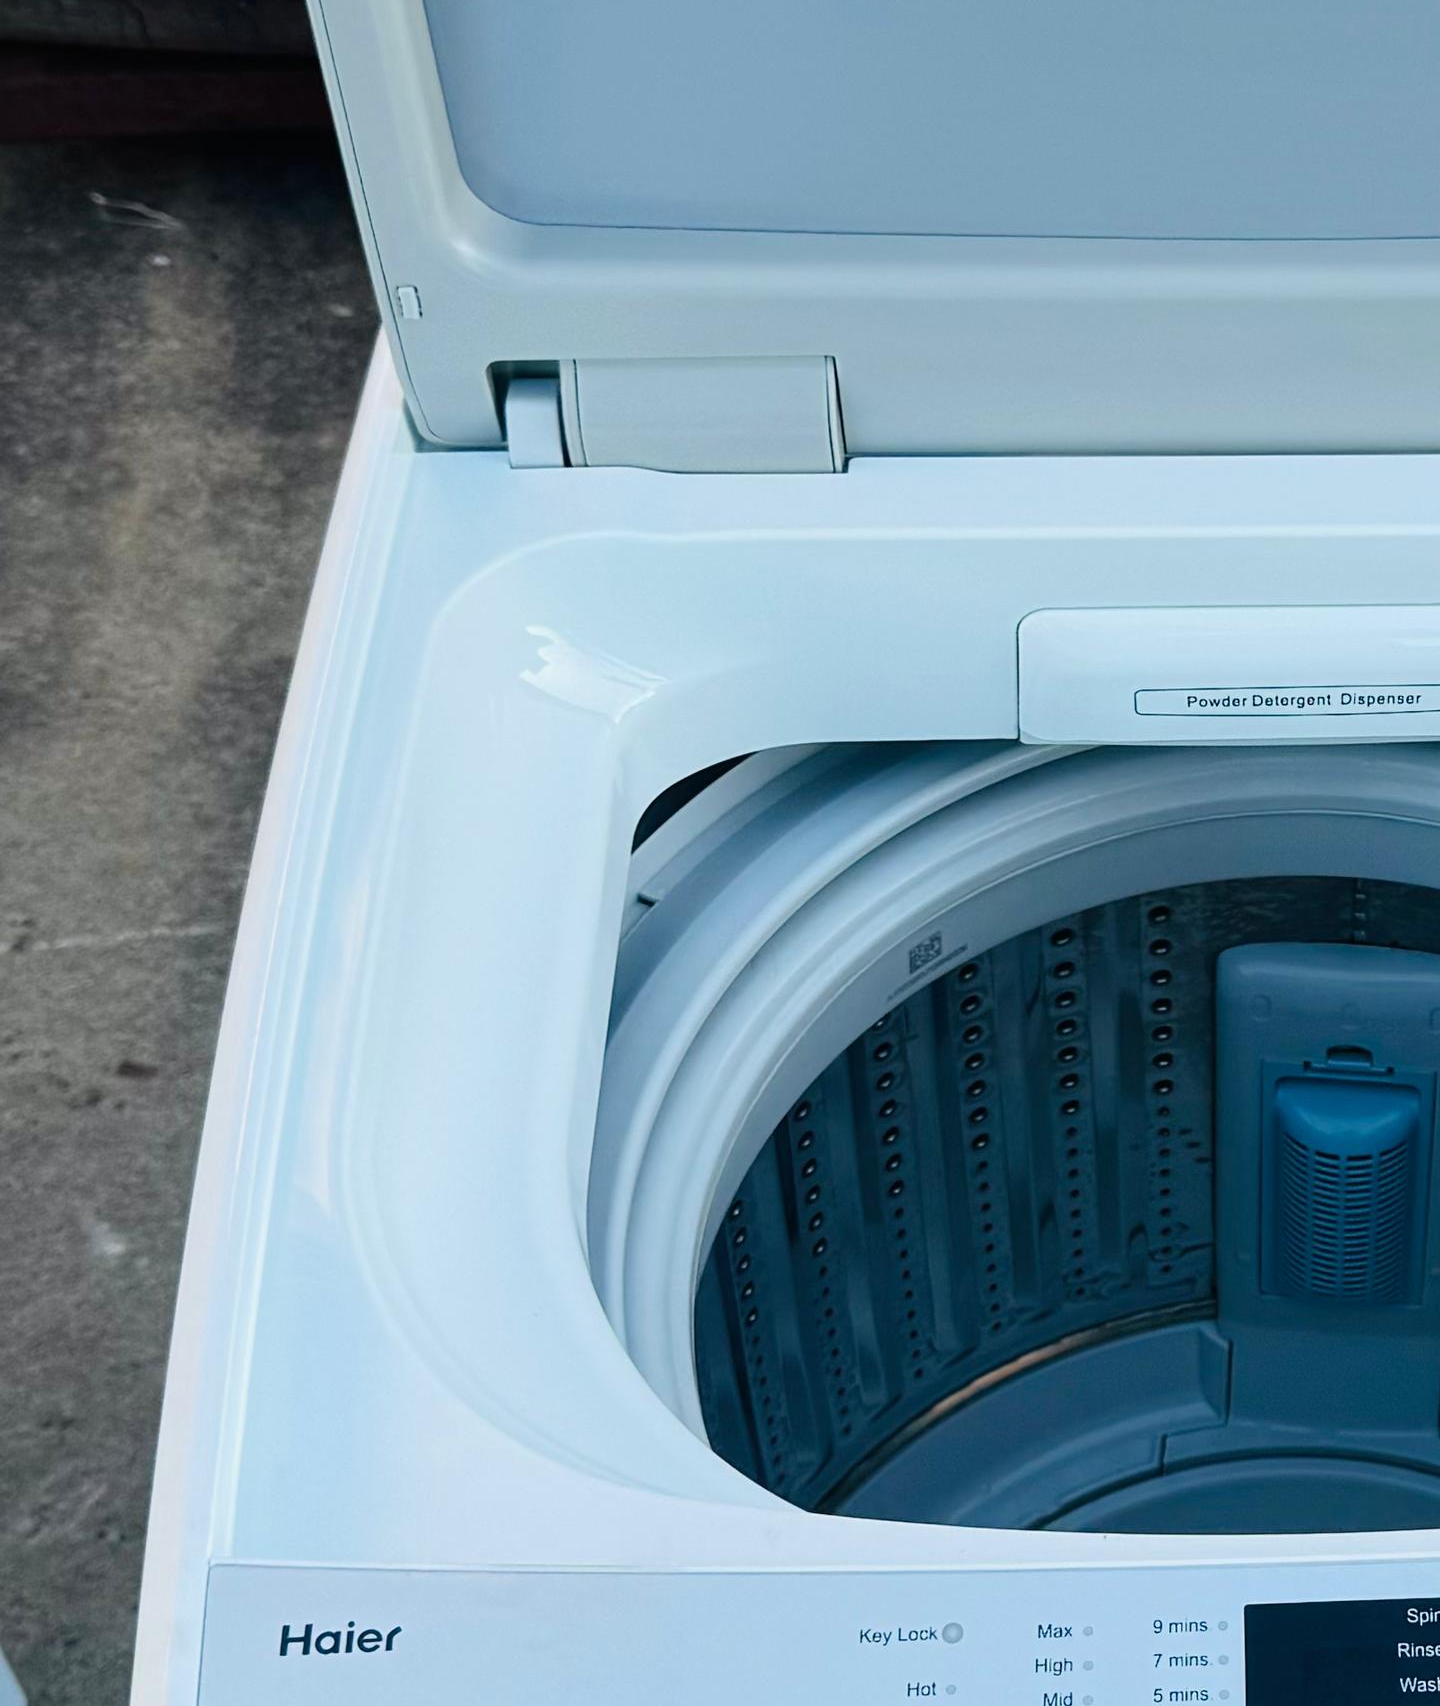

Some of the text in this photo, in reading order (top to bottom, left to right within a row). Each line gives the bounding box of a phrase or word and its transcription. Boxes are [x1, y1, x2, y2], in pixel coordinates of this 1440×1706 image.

[1186, 692, 1422, 709] Powder Detergent Dispenser
[1037, 1623, 1073, 1639] Max
[1152, 1619, 1164, 1634] 9
[279, 1620, 403, 1657] Haier
[859, 1626, 938, 1647] Key Lock
[1035, 1657, 1073, 1677] High
[1153, 1653, 1163, 1668] 7
[907, 1682, 937, 1698] Hot
[1153, 1688, 1164, 1703] 5
